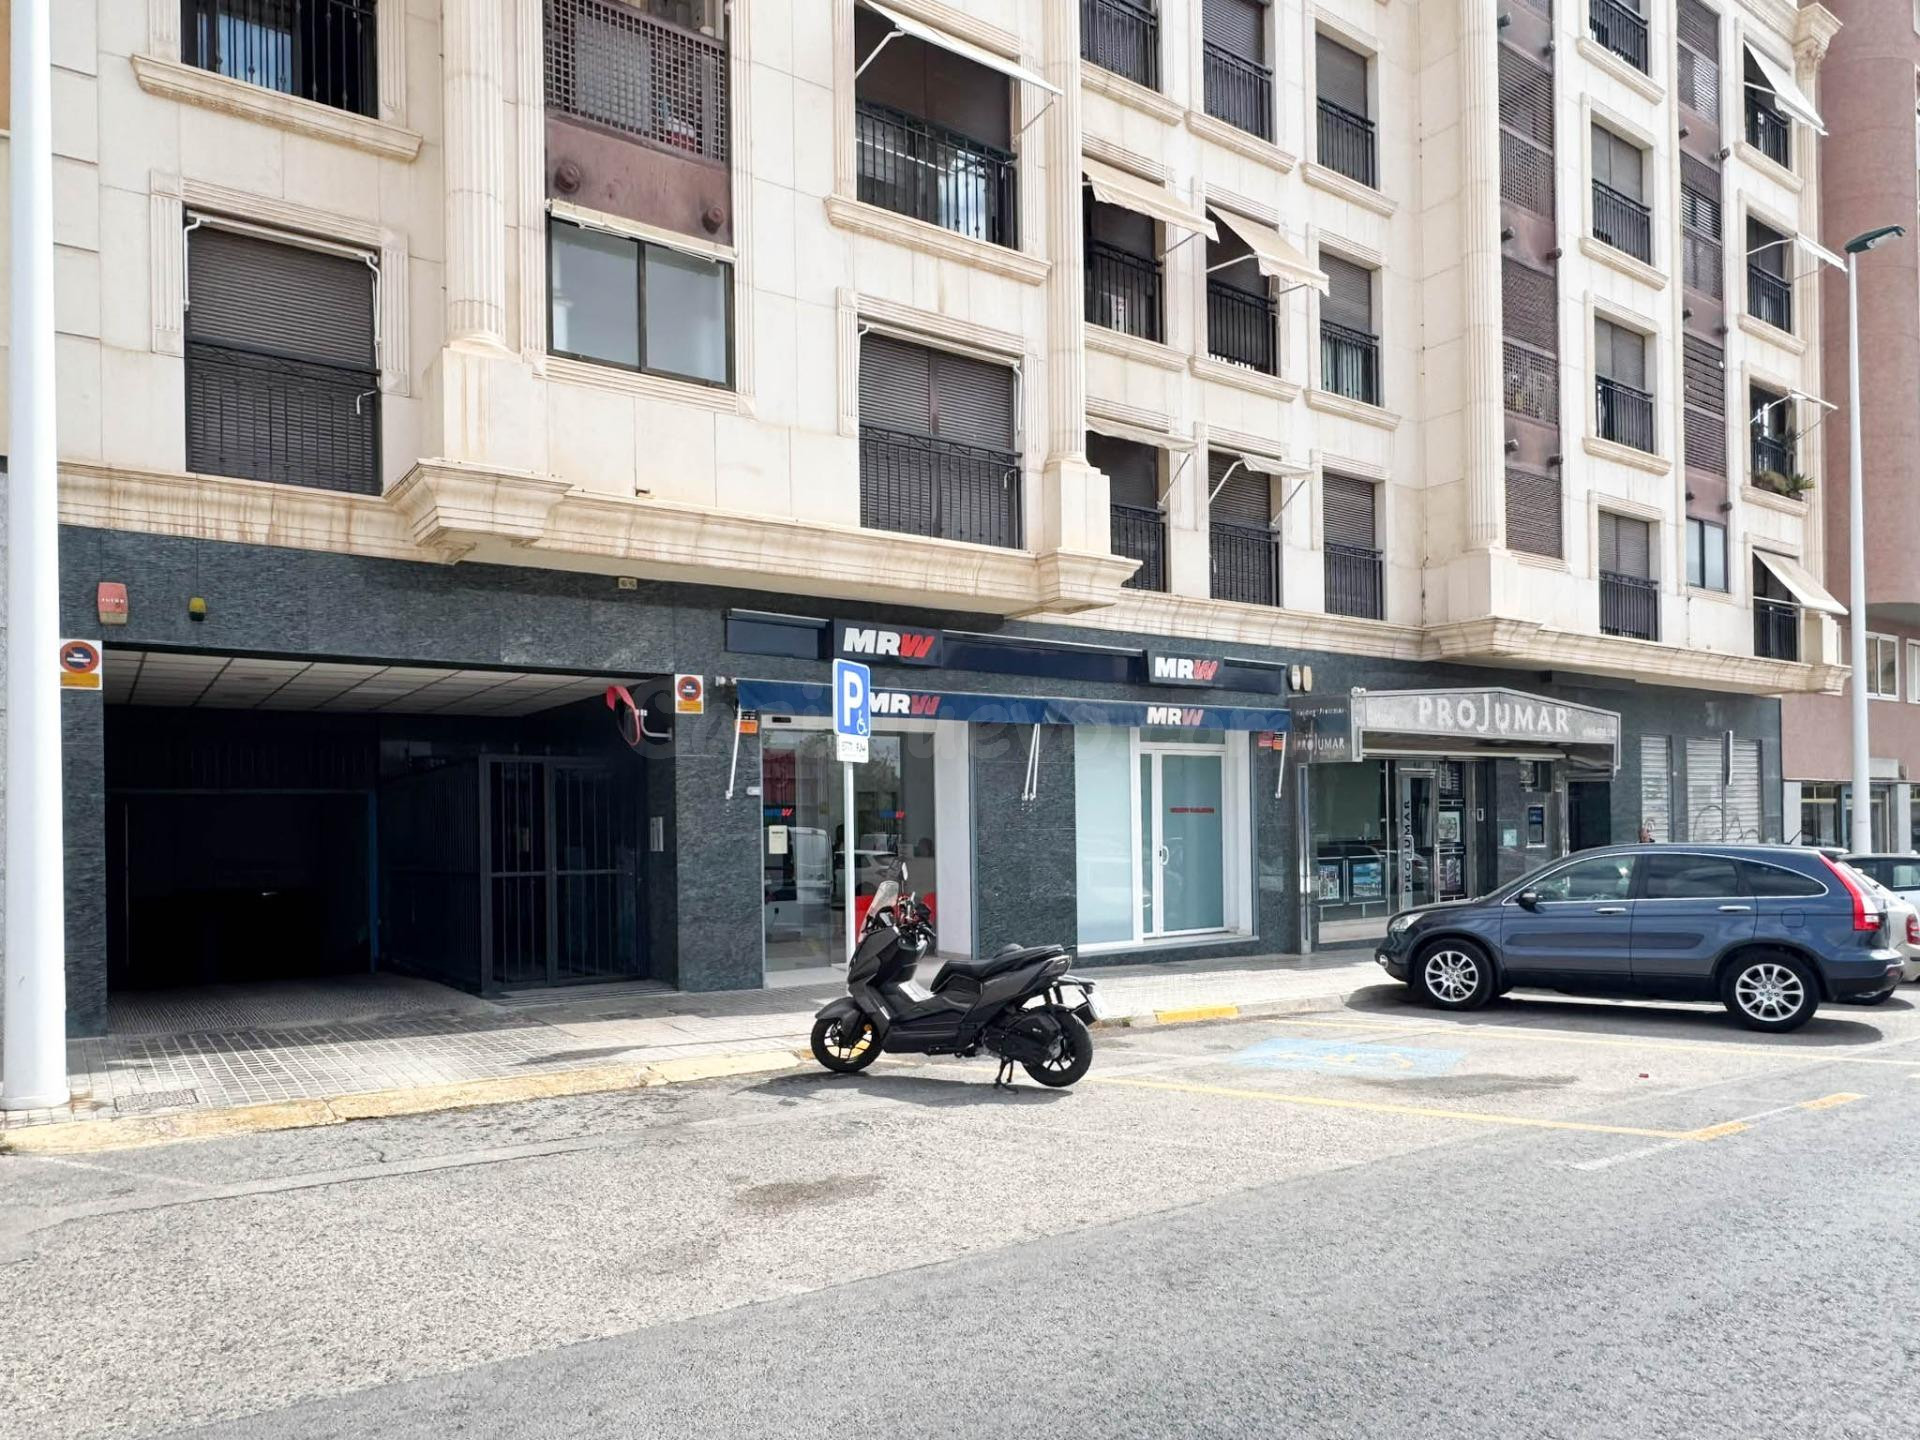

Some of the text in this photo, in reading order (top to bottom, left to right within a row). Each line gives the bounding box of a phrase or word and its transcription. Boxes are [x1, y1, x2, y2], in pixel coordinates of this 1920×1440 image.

[843, 626, 935, 659] MRW
[1153, 656, 1219, 681] MRW
[843, 670, 864, 727] P
[869, 691, 941, 716] MRW
[1146, 705, 1205, 728] MRW
[1417, 693, 1570, 734] PROJUMAR
